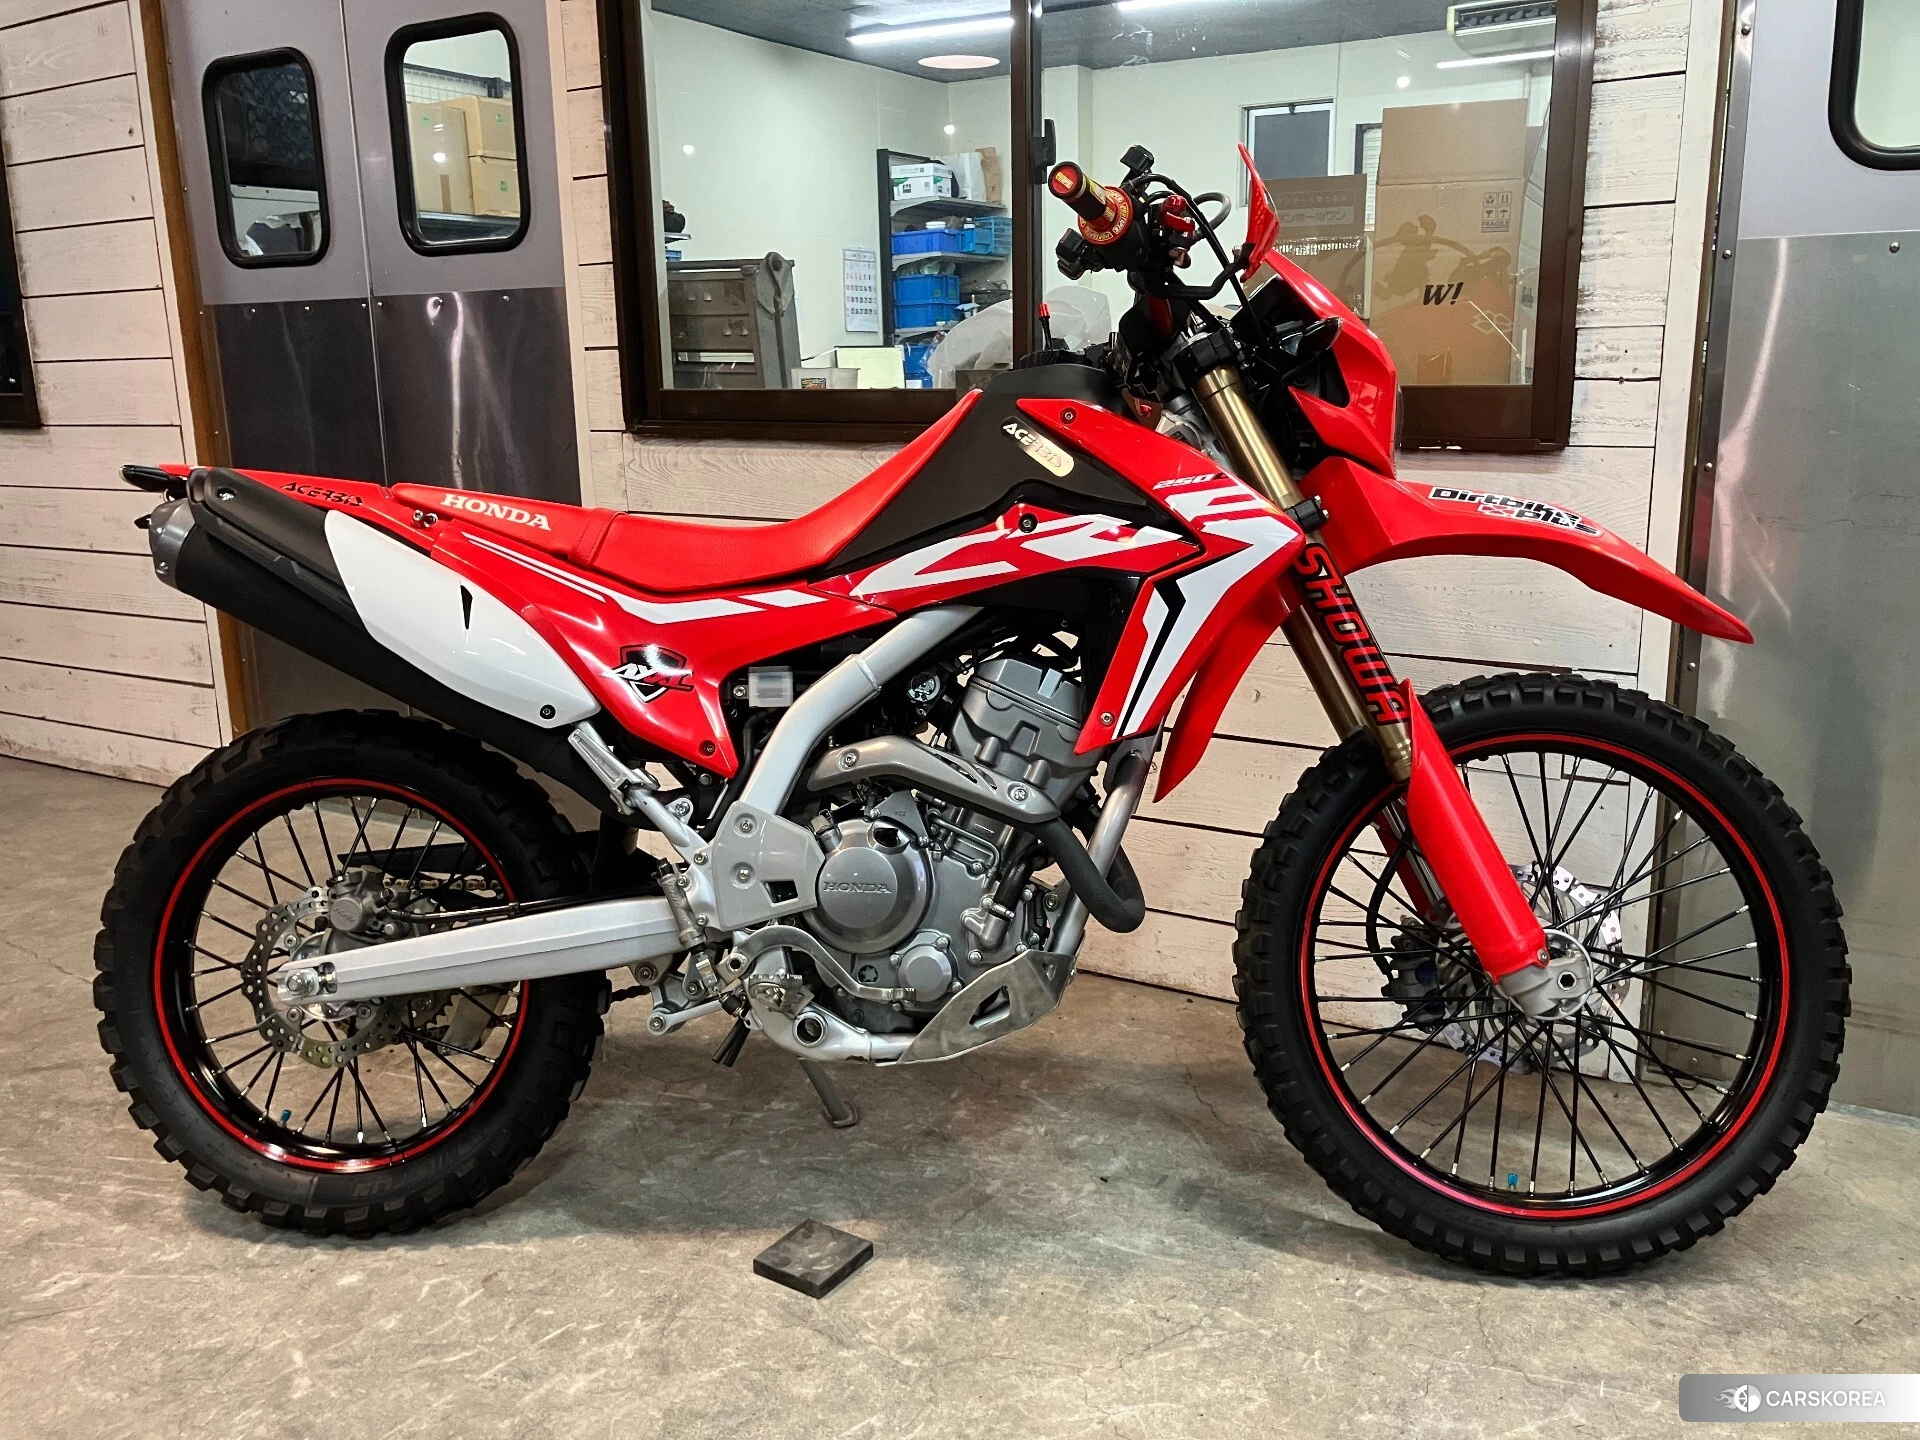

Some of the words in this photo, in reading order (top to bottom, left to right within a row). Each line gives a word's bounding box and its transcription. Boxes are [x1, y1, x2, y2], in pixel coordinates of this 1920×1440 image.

[1422, 281, 1465, 306] W!
[439, 492, 552, 531] HONDA
[1293, 543, 1412, 725] SHOWA
[823, 881, 892, 894] HONDA
